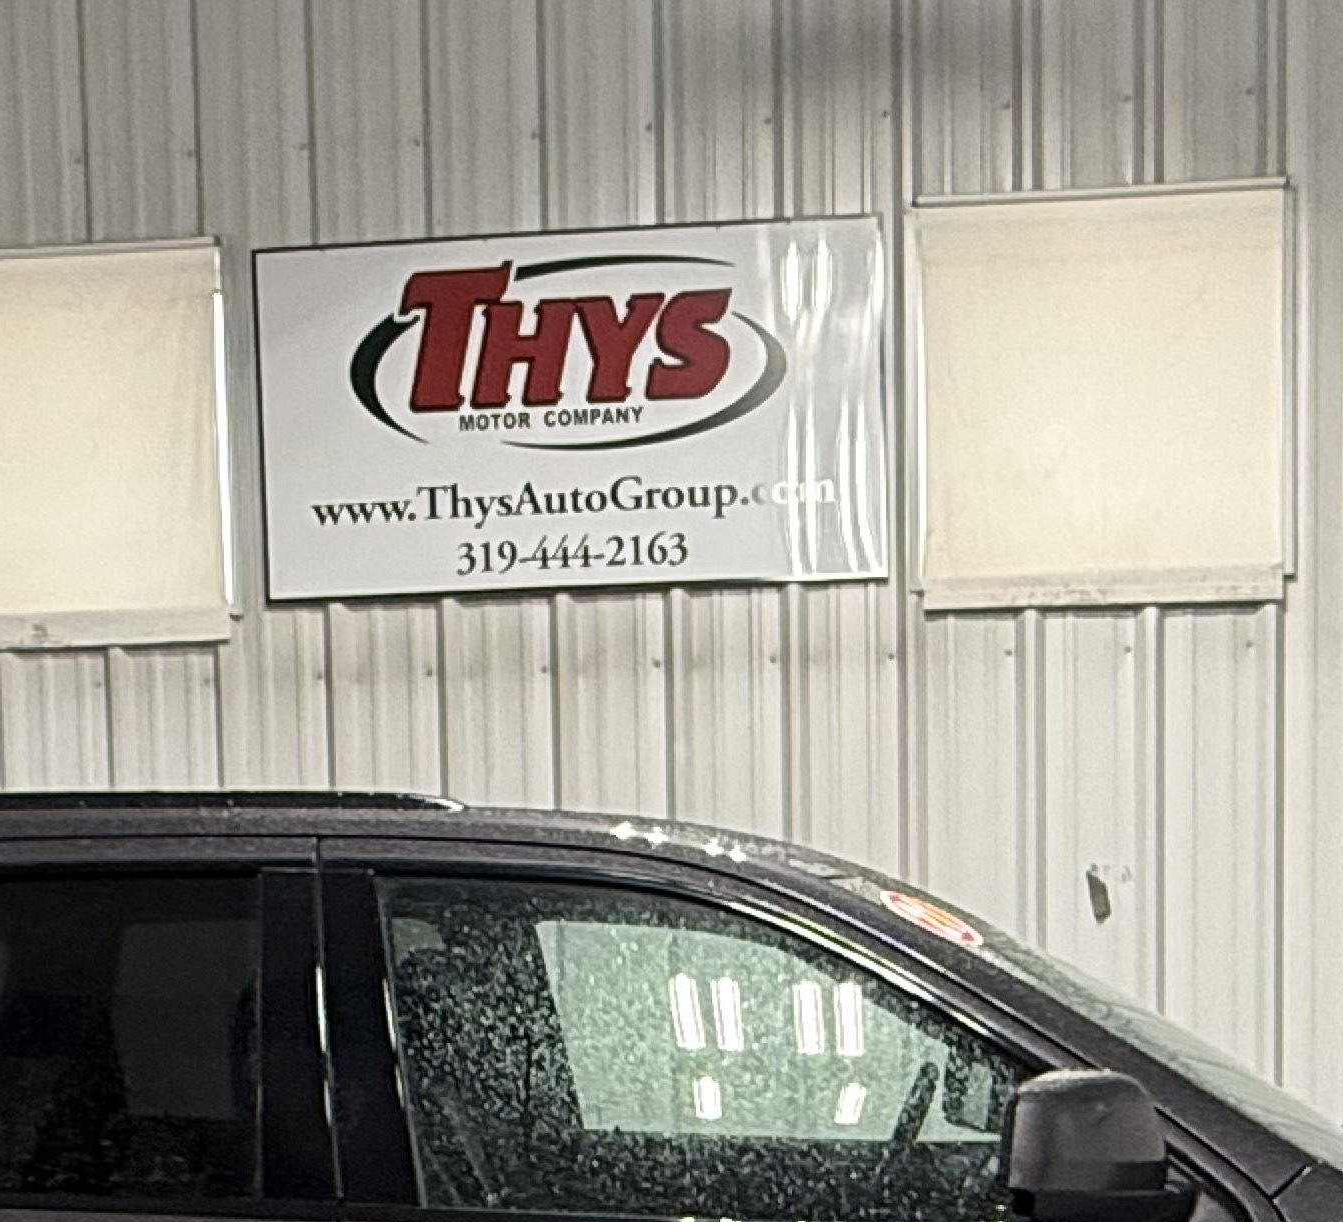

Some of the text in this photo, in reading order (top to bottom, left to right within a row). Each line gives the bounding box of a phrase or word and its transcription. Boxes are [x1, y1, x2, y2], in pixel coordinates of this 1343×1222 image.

[399, 260, 733, 413] THYS
[459, 406, 644, 431] MOTOR COMPANY
[456, 531, 689, 576] 319-444-2163
